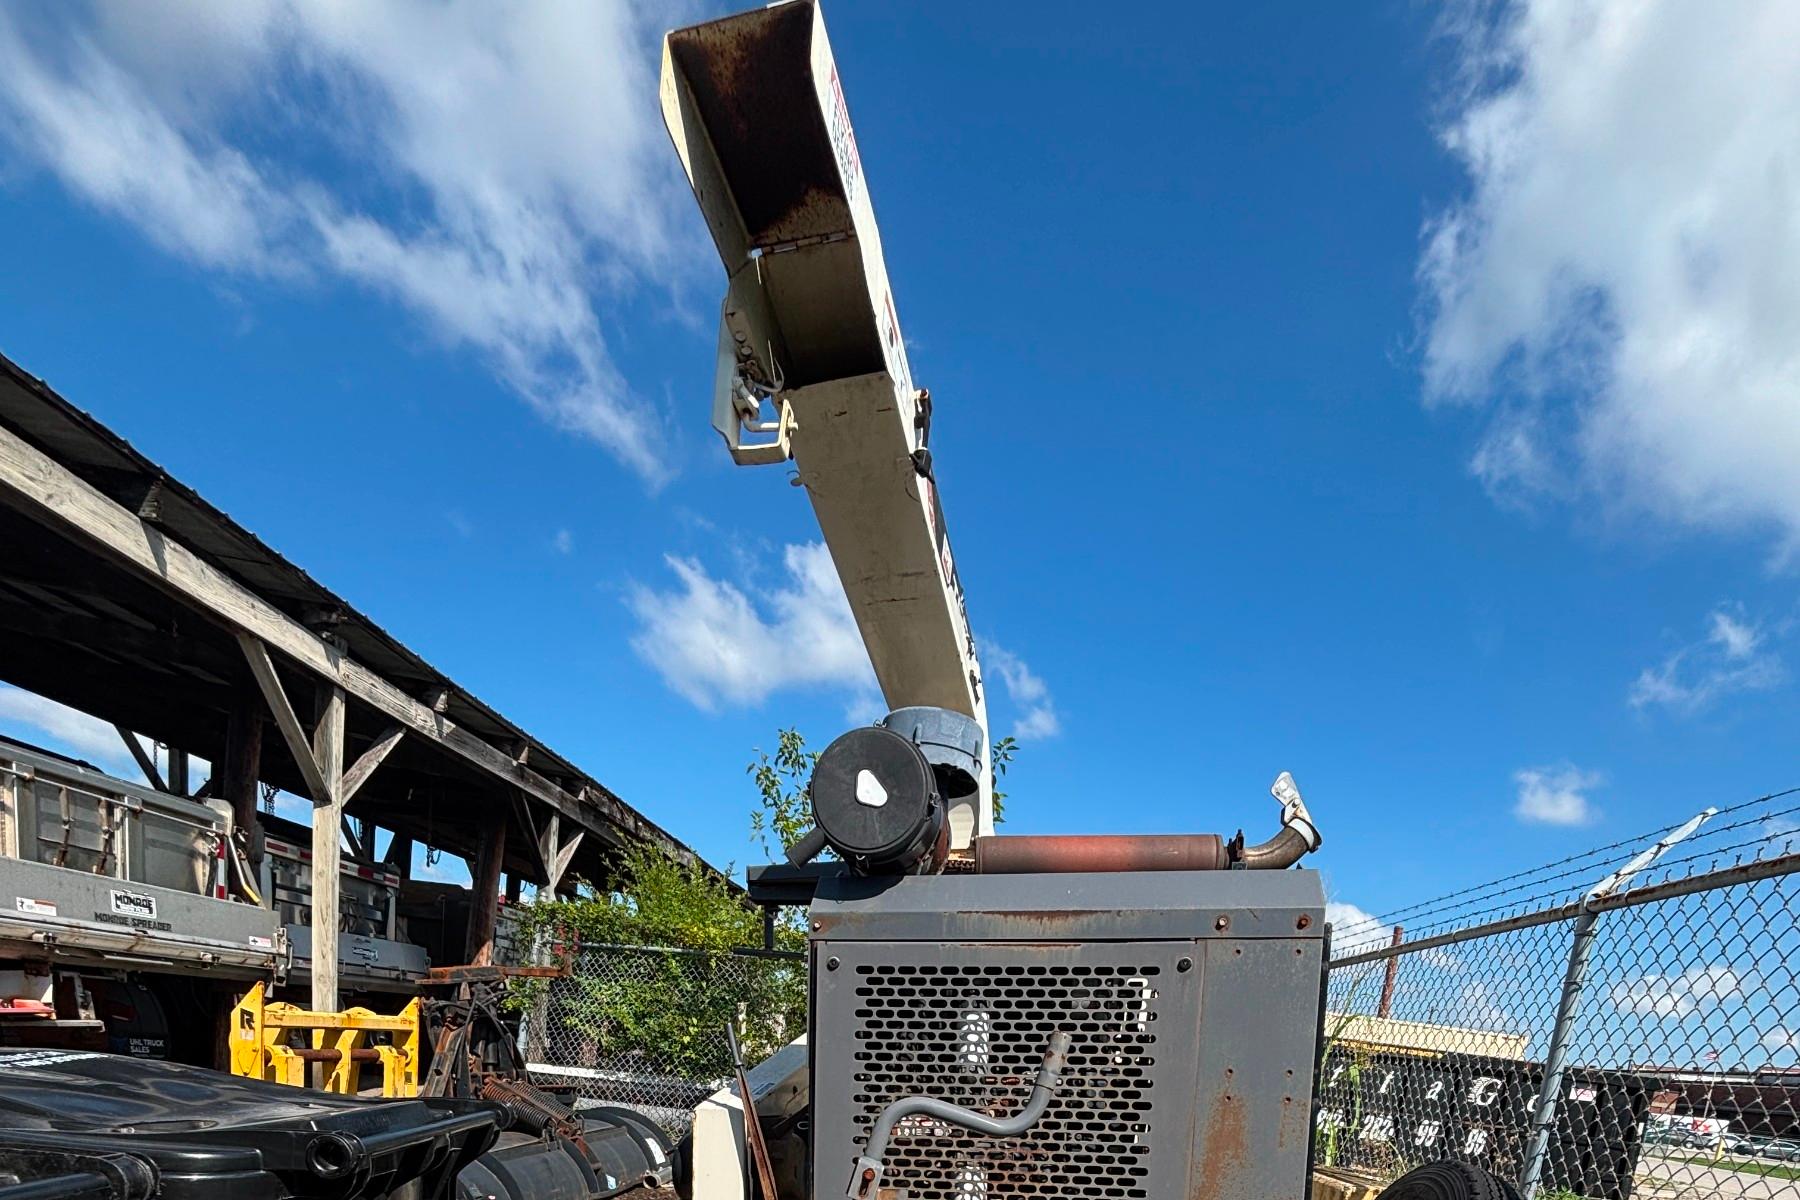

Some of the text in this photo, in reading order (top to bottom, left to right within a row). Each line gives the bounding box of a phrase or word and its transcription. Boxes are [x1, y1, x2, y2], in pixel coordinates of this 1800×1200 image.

[114, 893, 154, 913] MONROE
[94, 911, 172, 932] MONROE SPREADER
[130, 1045, 150, 1054] SALES
[143, 1038, 165, 1047] TRUCK
